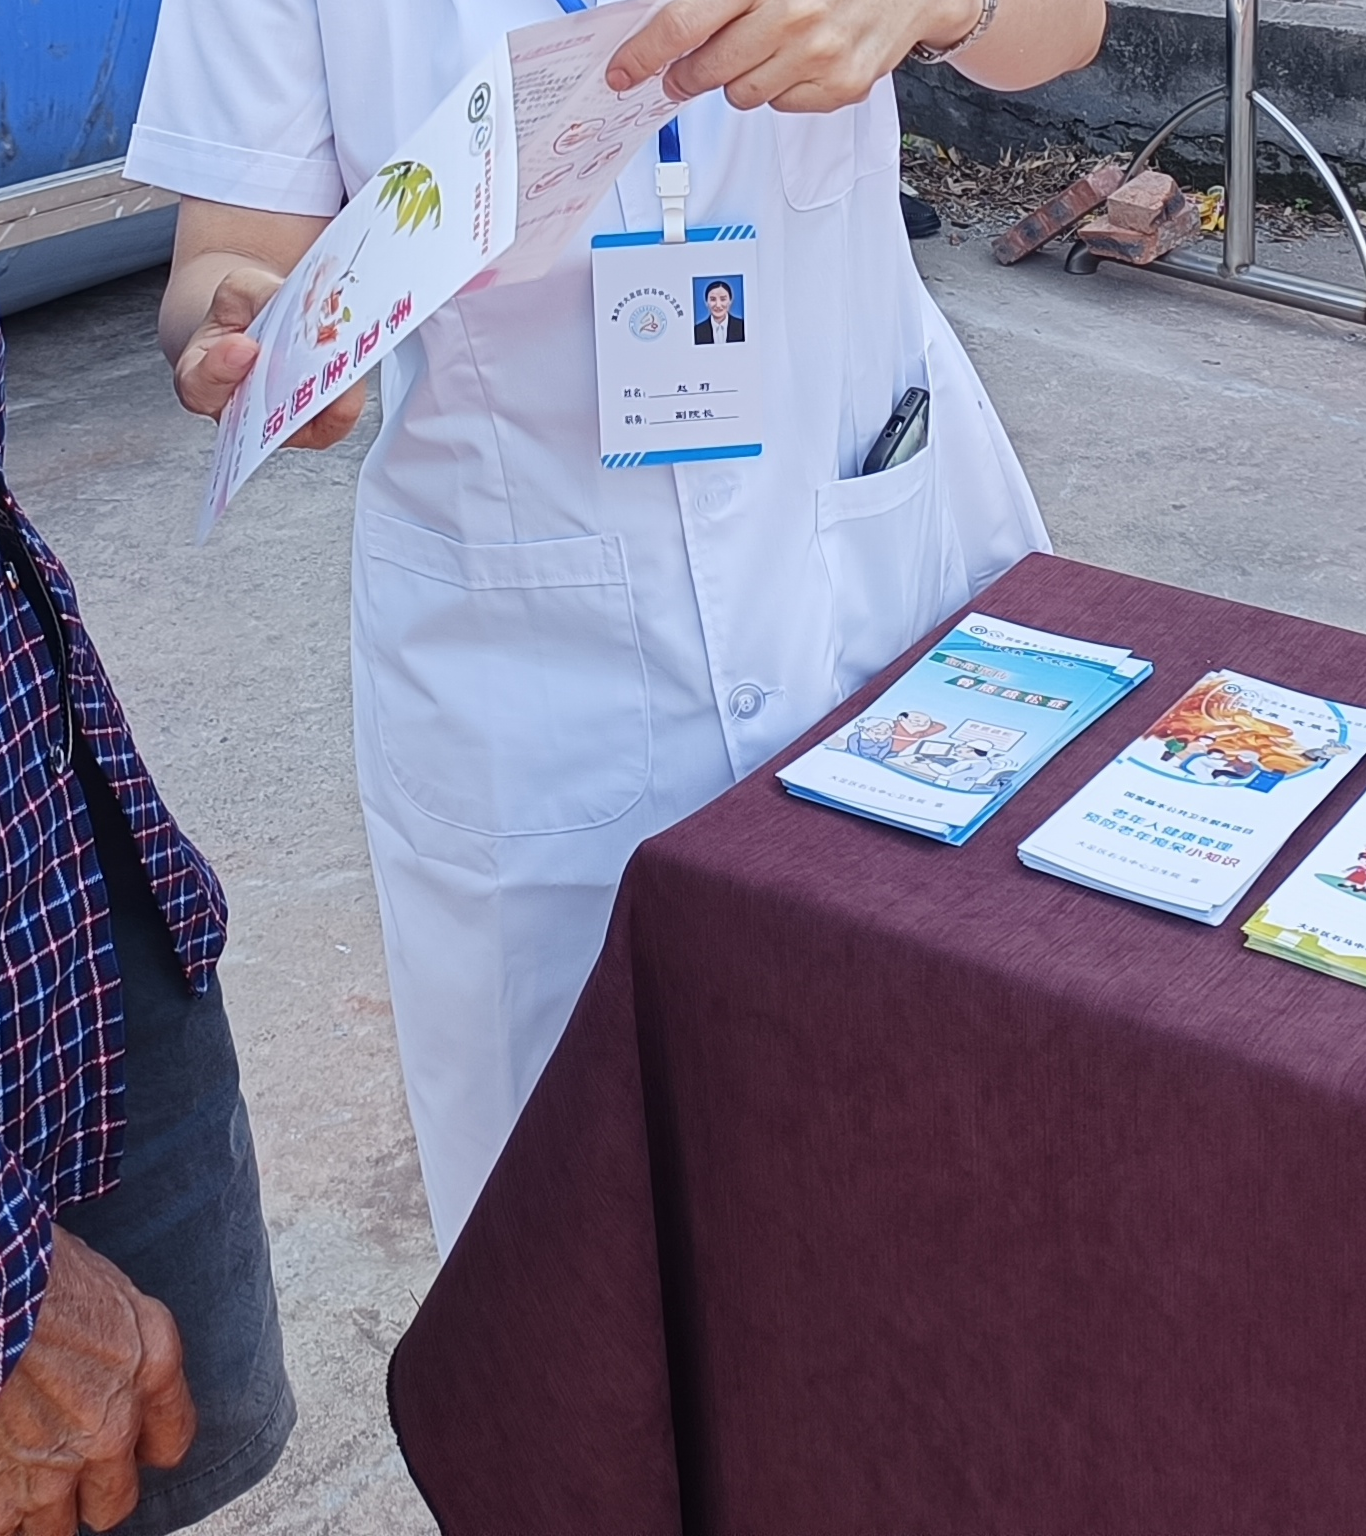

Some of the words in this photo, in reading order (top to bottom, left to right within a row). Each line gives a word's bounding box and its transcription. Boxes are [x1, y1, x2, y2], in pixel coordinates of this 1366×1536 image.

[1081, 811, 1241, 869] 预防老年痴呆小知识
[1111, 807, 1234, 852] 老年人健康管理
